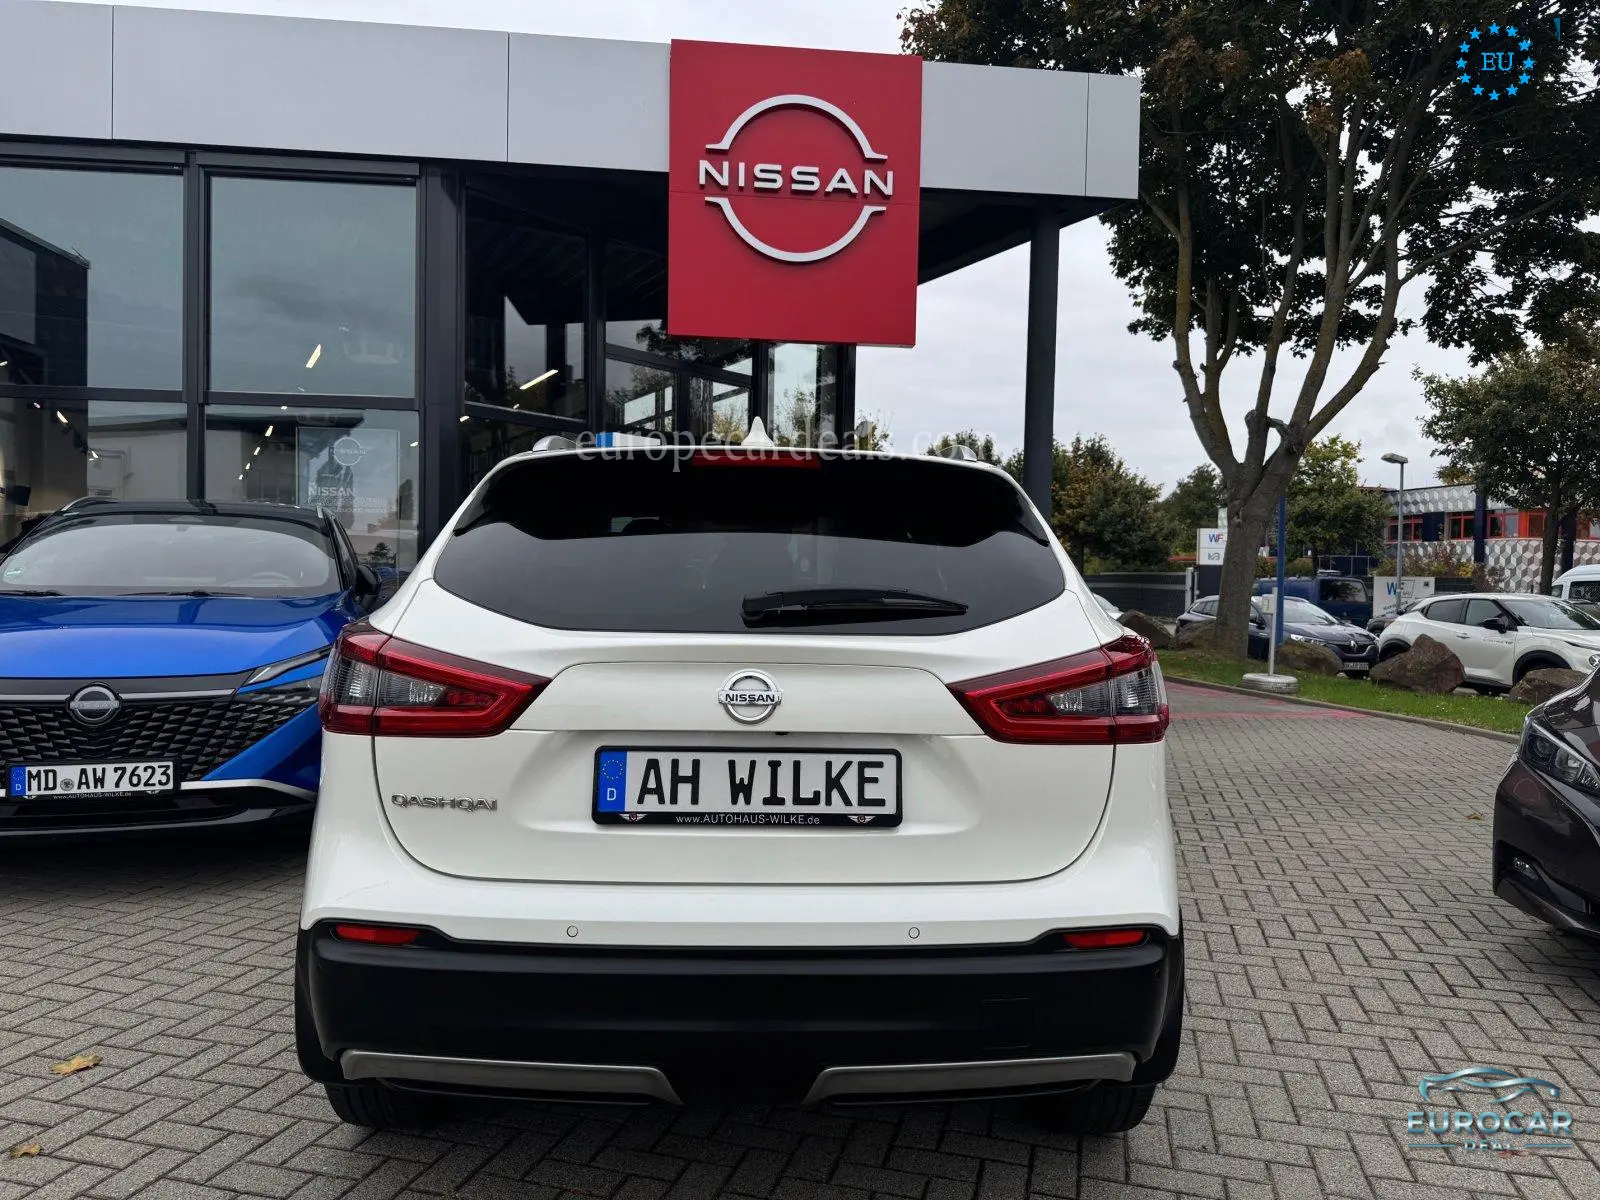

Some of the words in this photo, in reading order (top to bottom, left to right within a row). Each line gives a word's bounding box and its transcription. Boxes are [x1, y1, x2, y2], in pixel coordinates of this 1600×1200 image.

[698, 159, 894, 196] NISSAN
[308, 486, 356, 497] NISSAN
[724, 693, 775, 703] NISSAN
[15, 783, 22, 791] D
[27, 769, 57, 792] MD
[77, 767, 106, 790] AW
[113, 764, 171, 788] 7623
[607, 788, 616, 801] D
[637, 758, 700, 806] AH
[728, 759, 886, 807] WILKE
[391, 793, 498, 814] QASHQAI
[676, 813, 820, 825] www.AUTOHAUS-WILKE.de
